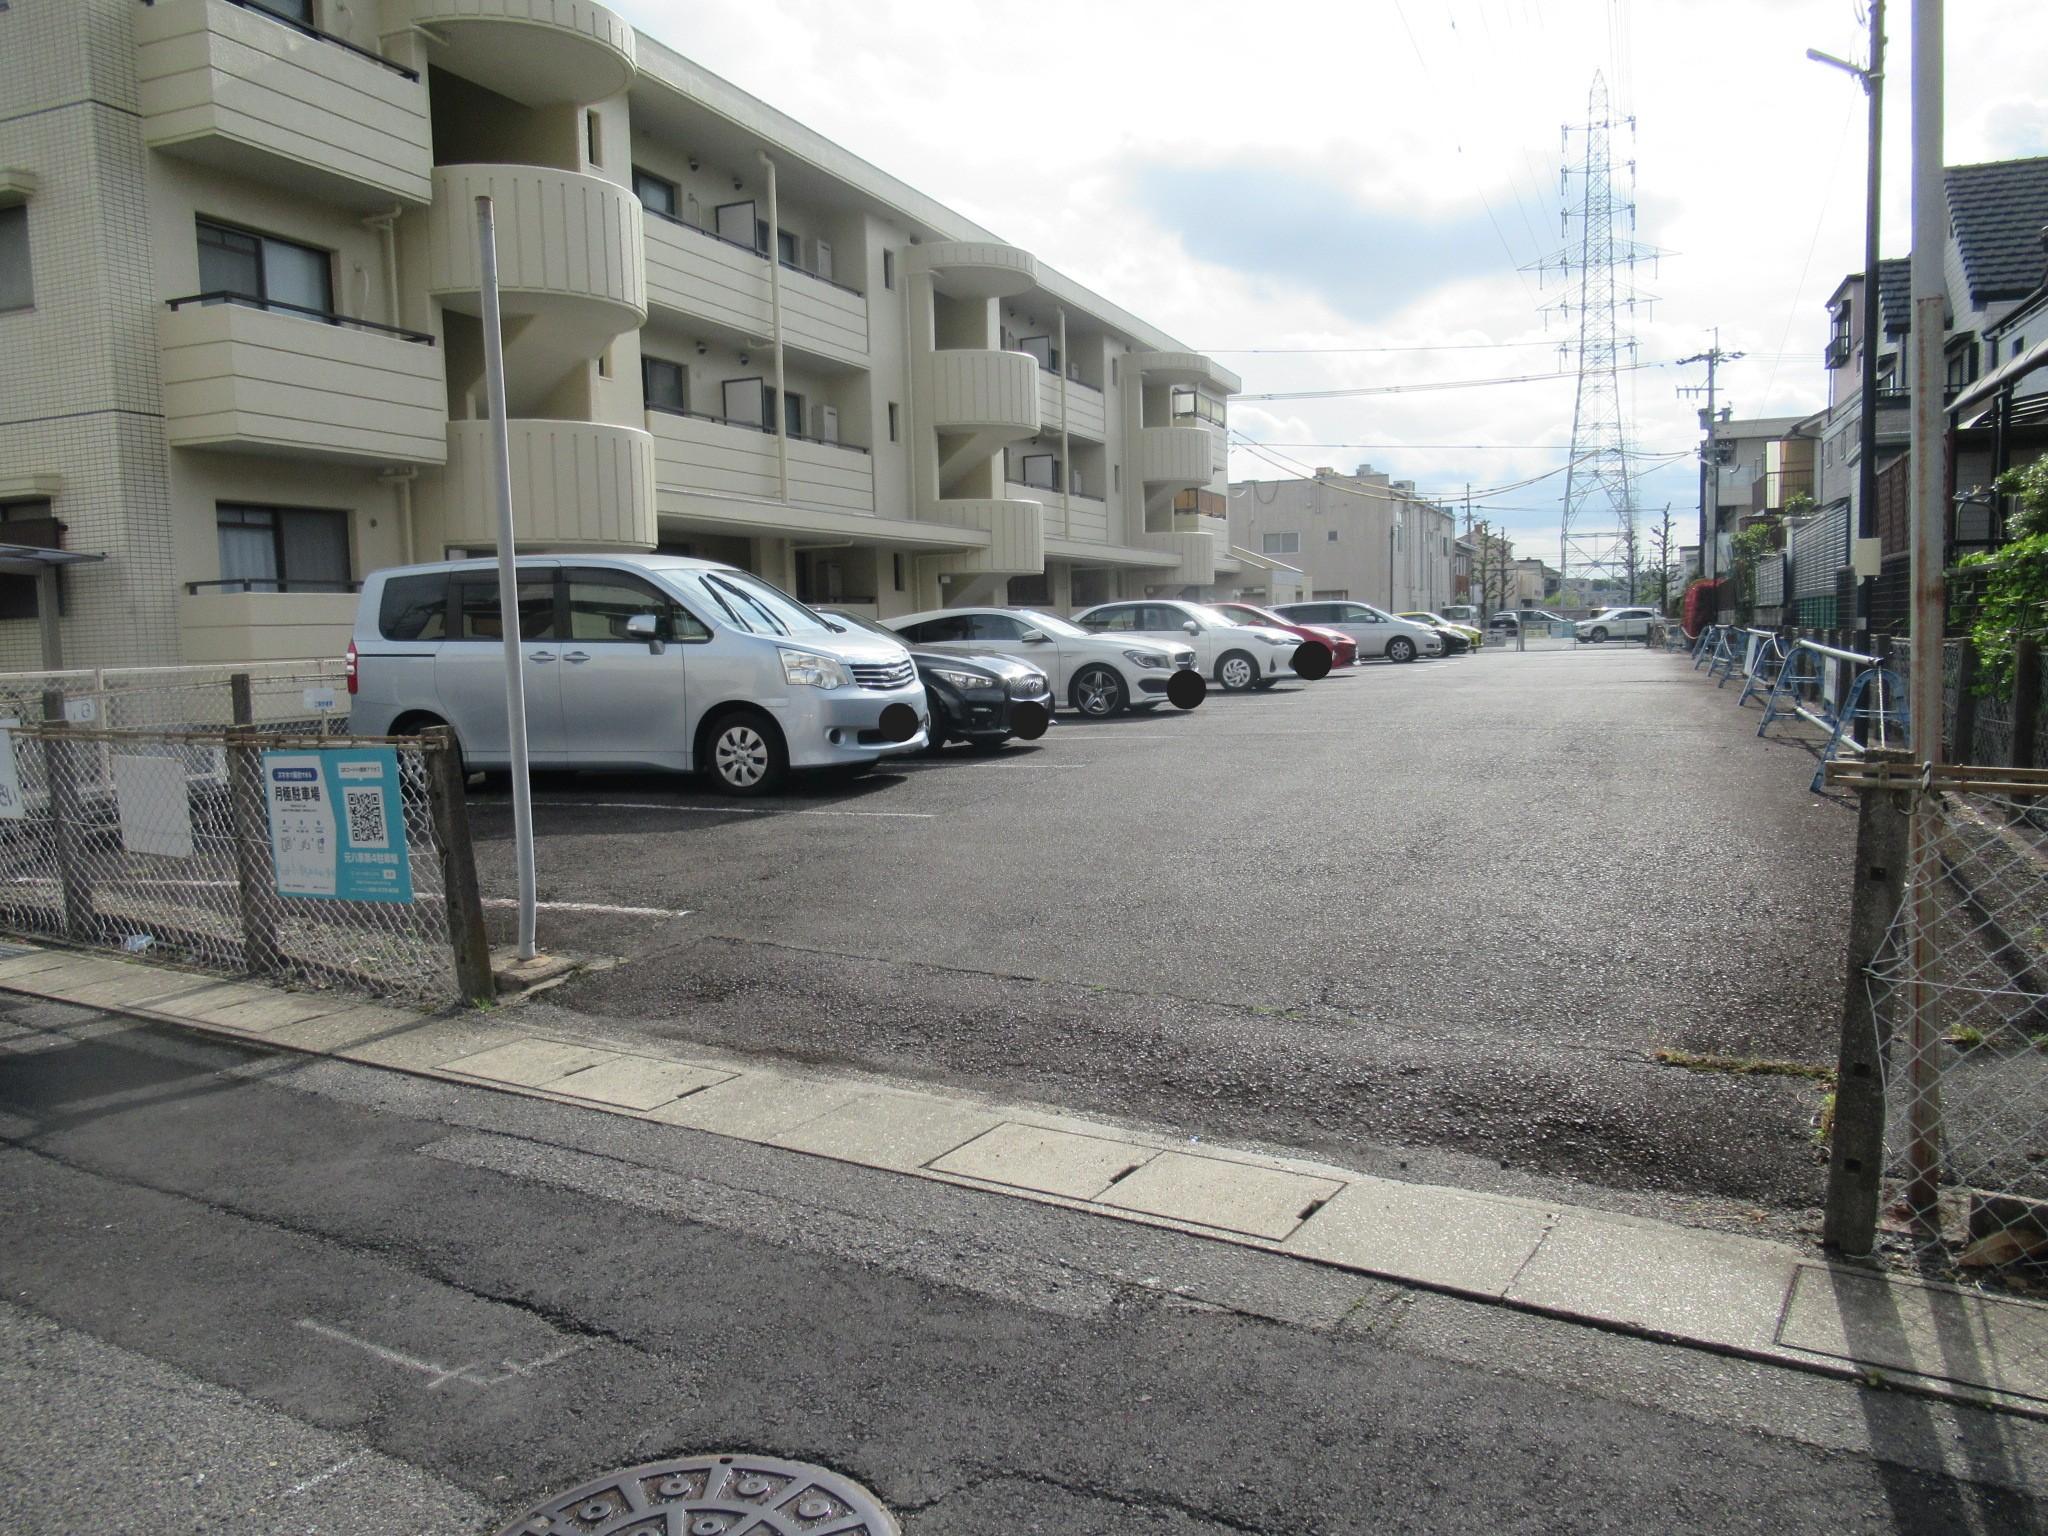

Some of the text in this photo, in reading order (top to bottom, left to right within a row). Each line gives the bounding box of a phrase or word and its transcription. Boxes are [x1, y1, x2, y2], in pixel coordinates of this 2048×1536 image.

[275, 786, 320, 802] 月極駐車場
